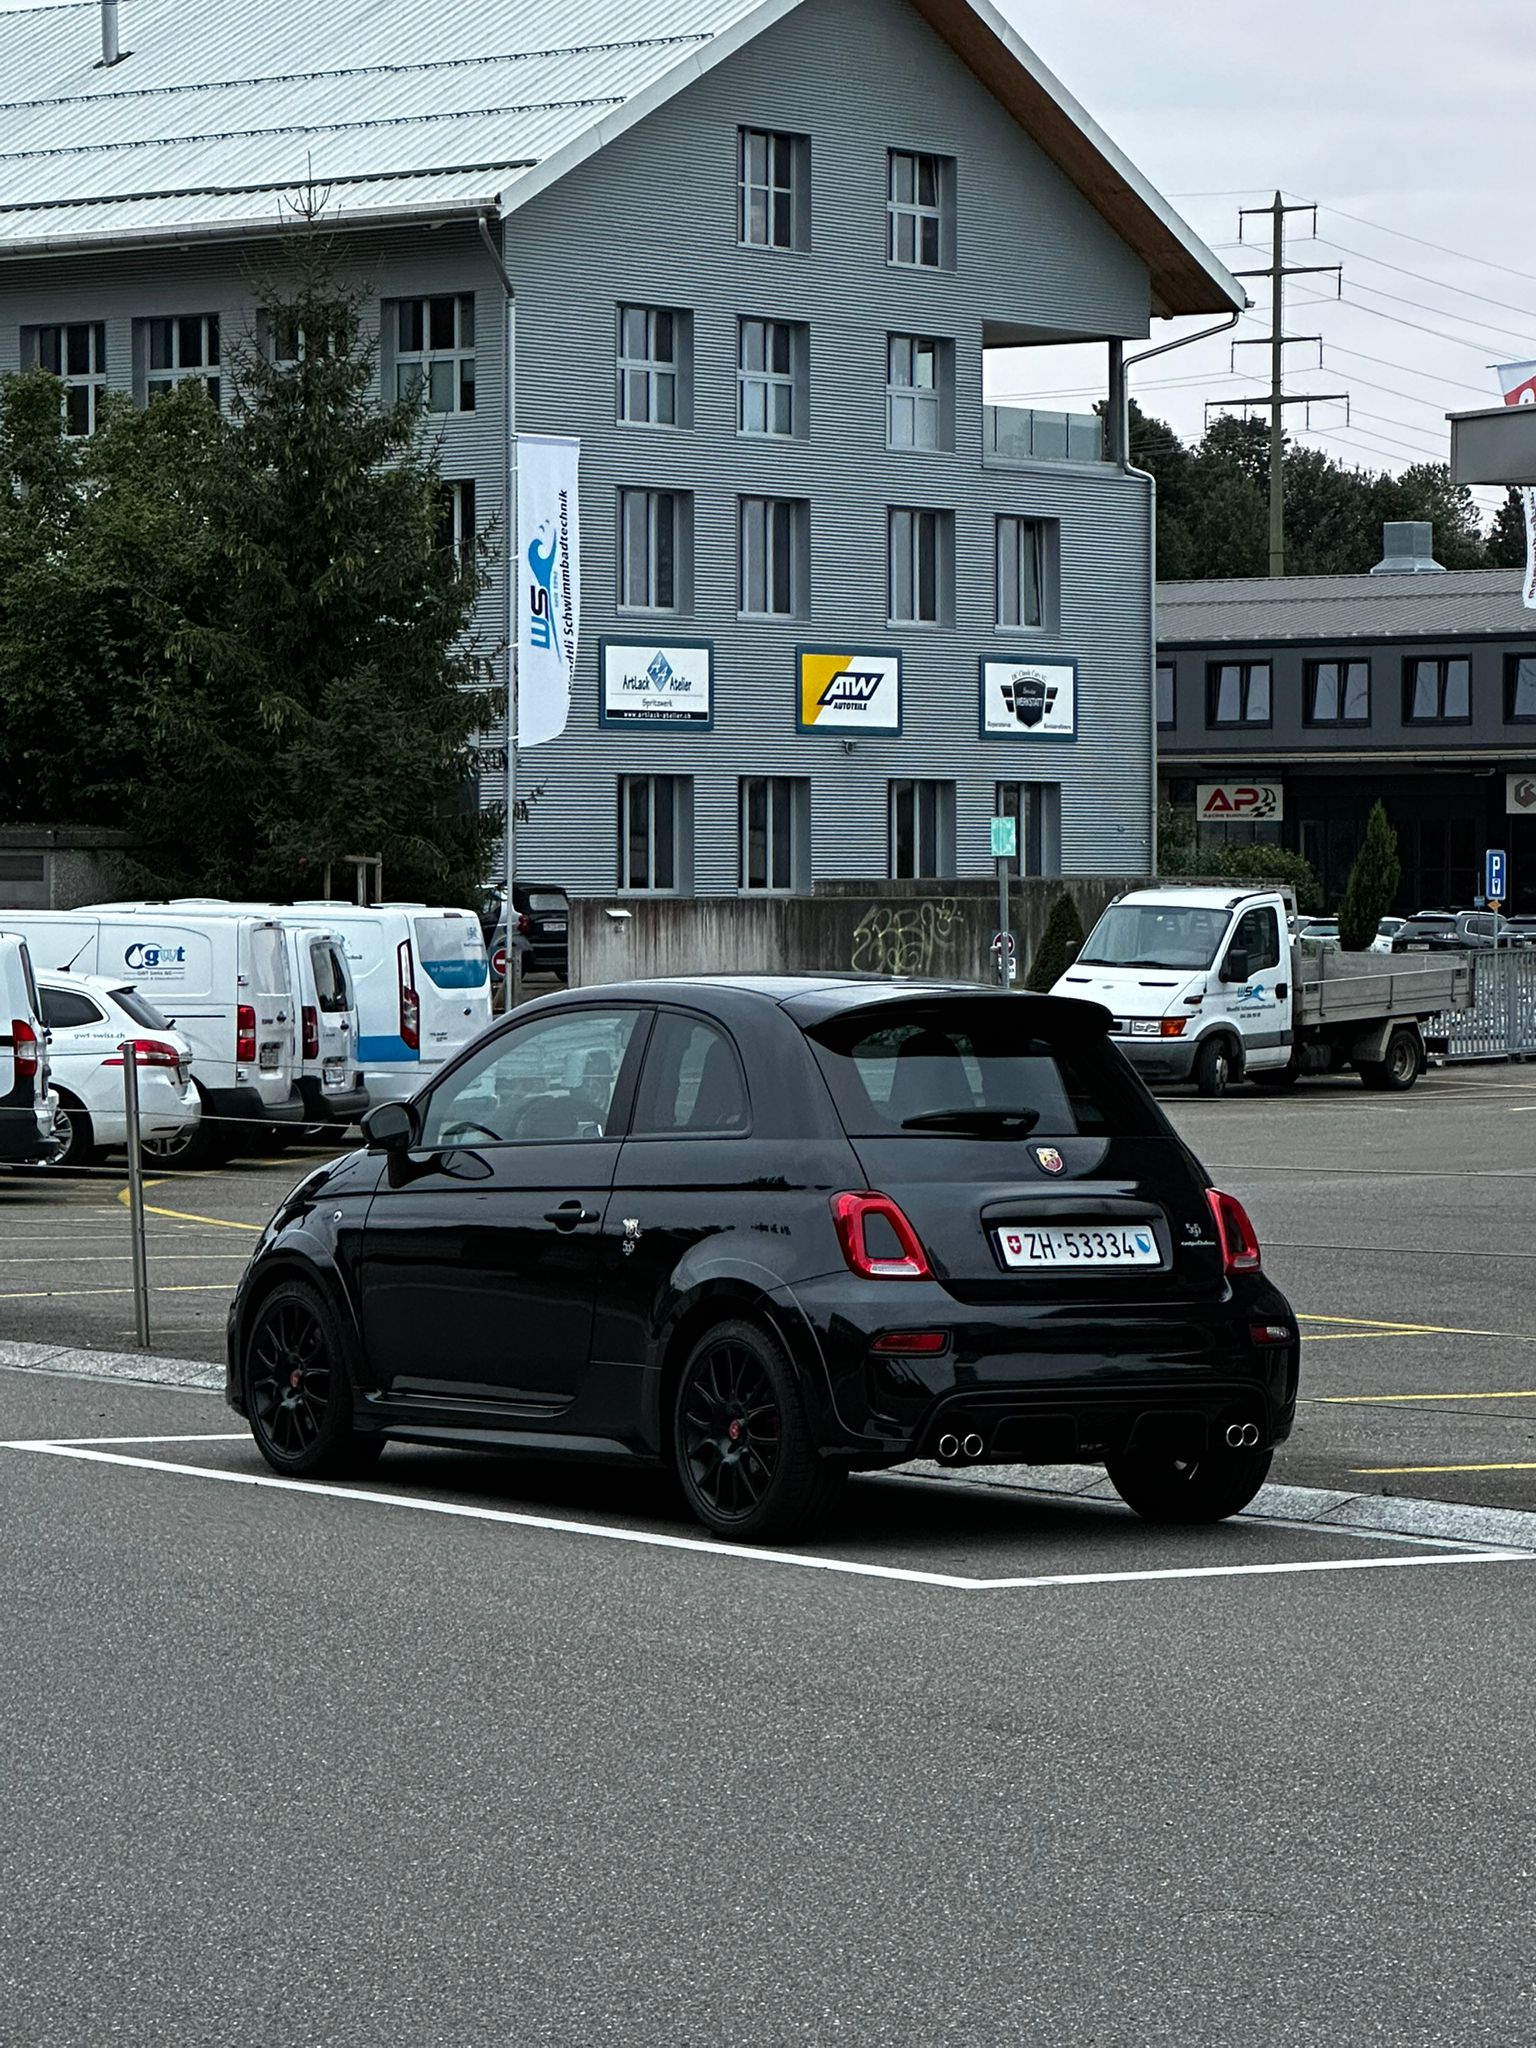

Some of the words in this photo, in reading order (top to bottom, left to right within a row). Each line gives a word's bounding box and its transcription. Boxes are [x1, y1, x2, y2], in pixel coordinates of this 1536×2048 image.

[559, 489, 574, 636] Schwimmbadtechnik
[530, 585, 550, 650] WS
[669, 676, 692, 692] Atelier
[823, 676, 878, 701] ATW
[642, 698, 673, 709] Spritzwerk
[833, 702, 868, 711] AUTOTEILE
[1203, 787, 1260, 811] AP
[1492, 856, 1501, 877] P
[144, 946, 186, 967] gwt
